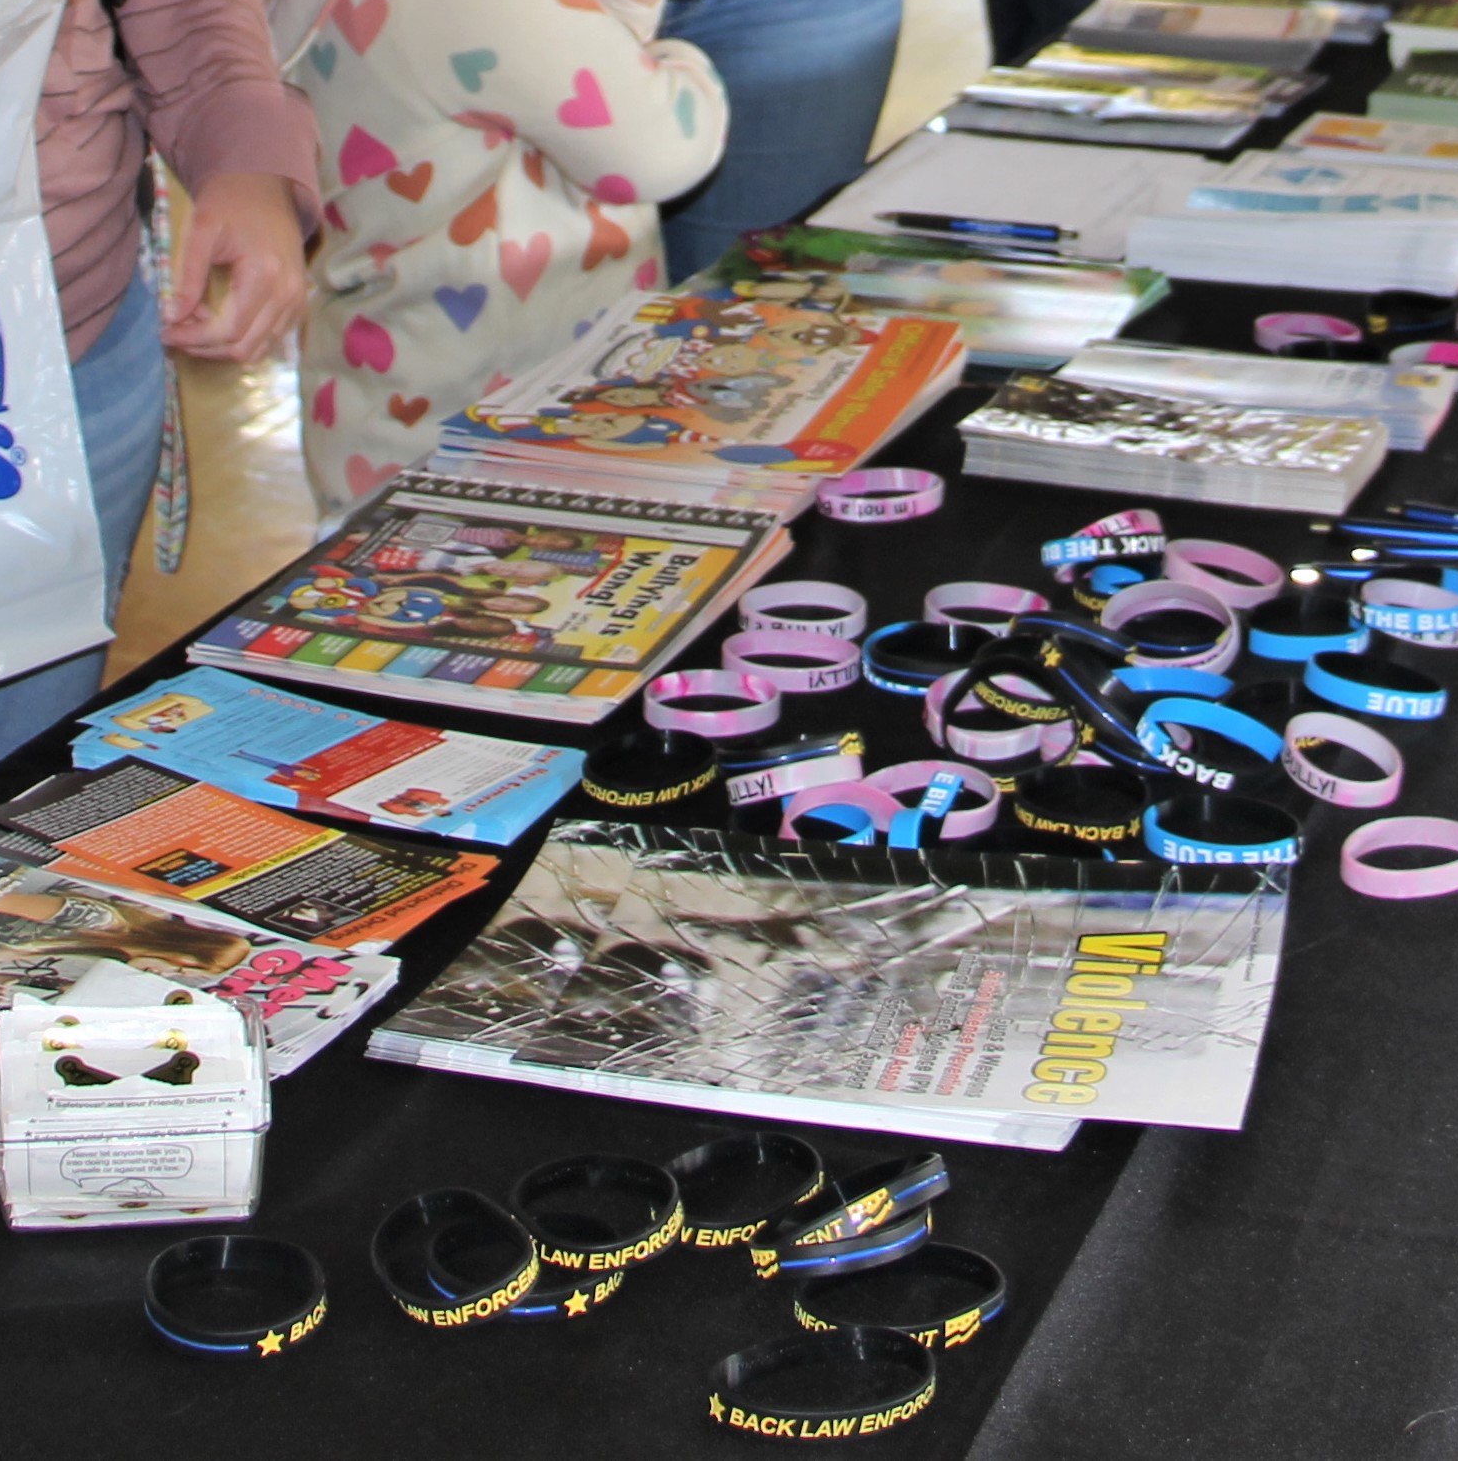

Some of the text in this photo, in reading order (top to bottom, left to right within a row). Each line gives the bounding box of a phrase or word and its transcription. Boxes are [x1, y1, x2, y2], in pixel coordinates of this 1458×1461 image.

[1065, 537, 1116, 558] THE
[584, 550, 661, 608] Wrong!
[599, 554, 700, 637] Bullying is
[1361, 606, 1411, 629] THE
[1366, 692, 1436, 716] BLUE
[1158, 742, 1236, 791] BACK
[654, 781, 690, 804] LAW
[1075, 824, 1126, 842] BACK
[1162, 838, 1235, 864] BLUE
[327, 880, 464, 941] Distracted Driving
[1025, 932, 1168, 1105] Violence
[875, 1022, 926, 1092] Sexual Assault
[934, 1045, 974, 1097] Prevention
[148, 1097, 184, 1109] Friendly
[186, 1095, 216, 1106] Sheriff
[66, 1158, 84, 1166] into
[85, 1158, 110, 1168] doing
[112, 1156, 159, 1167] something
[160, 1155, 176, 1164] that
[72, 1147, 180, 1158] Never let anyone talk you
[72, 1165, 101, 1174] unsafe
[114, 1164, 146, 1175] against
[147, 1164, 162, 1172] the
[540, 1243, 584, 1269] LAW
[594, 1270, 625, 1304] BAC
[728, 1406, 796, 1438] BACK
[800, 1417, 857, 1439] LAW
